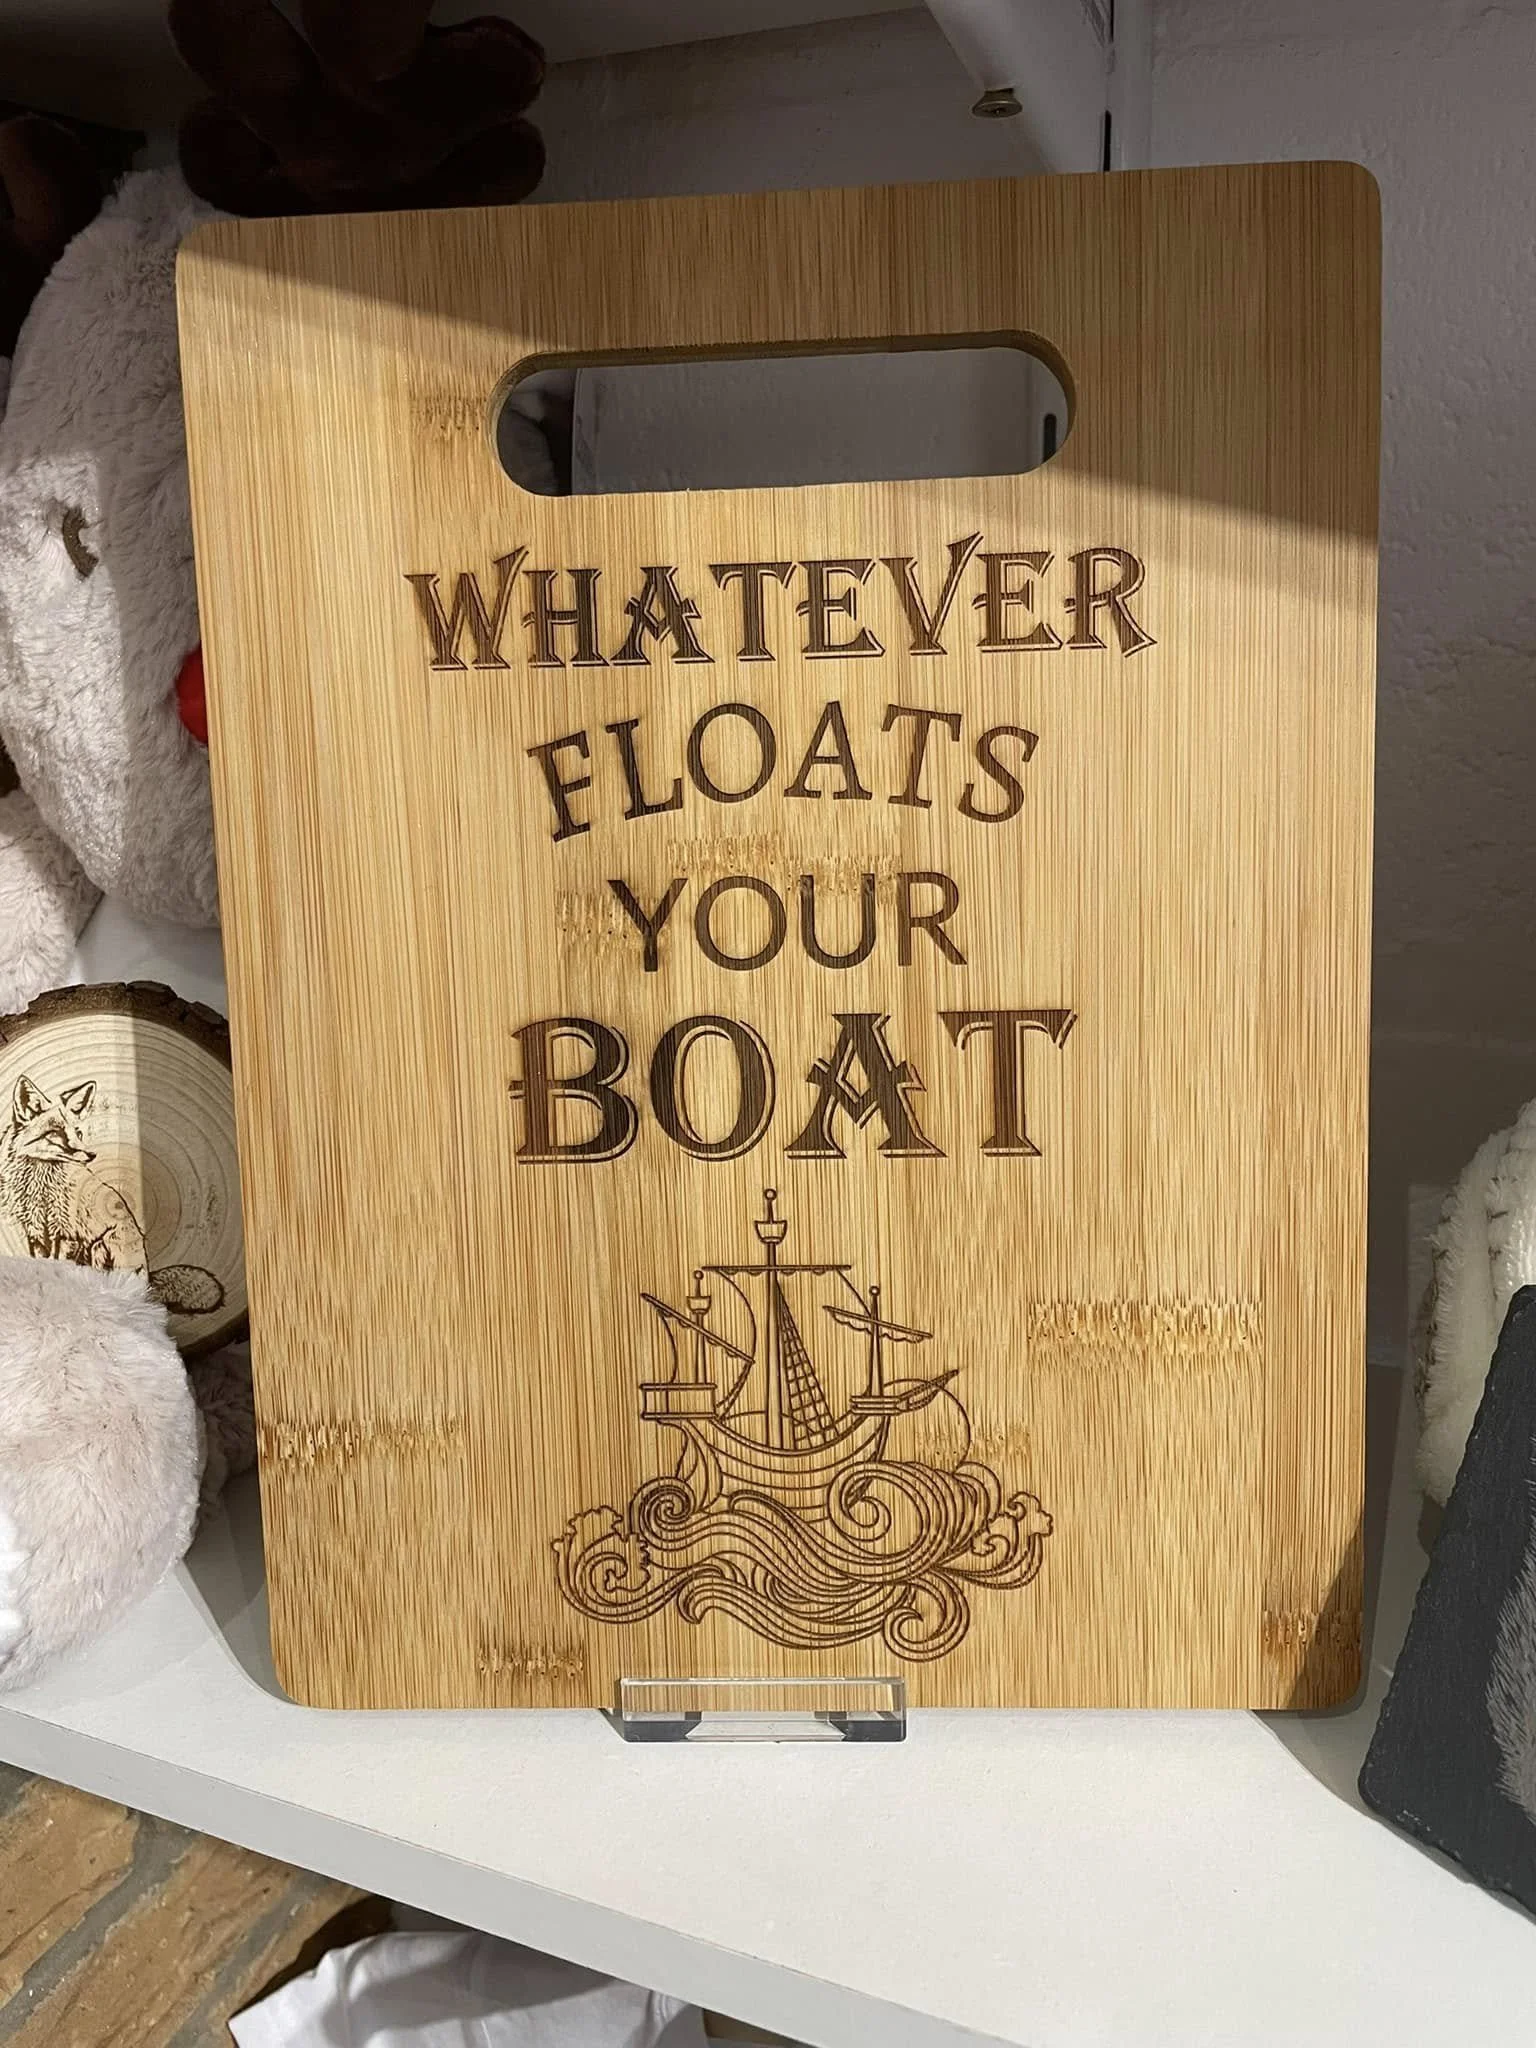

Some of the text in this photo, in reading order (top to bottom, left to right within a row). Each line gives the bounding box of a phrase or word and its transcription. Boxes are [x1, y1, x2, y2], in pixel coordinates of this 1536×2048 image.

[403, 531, 1158, 671] WHATEVER
[526, 700, 1040, 843] FLOATS
[607, 871, 968, 973] YOUR
[508, 1009, 1078, 1165] BOAT
